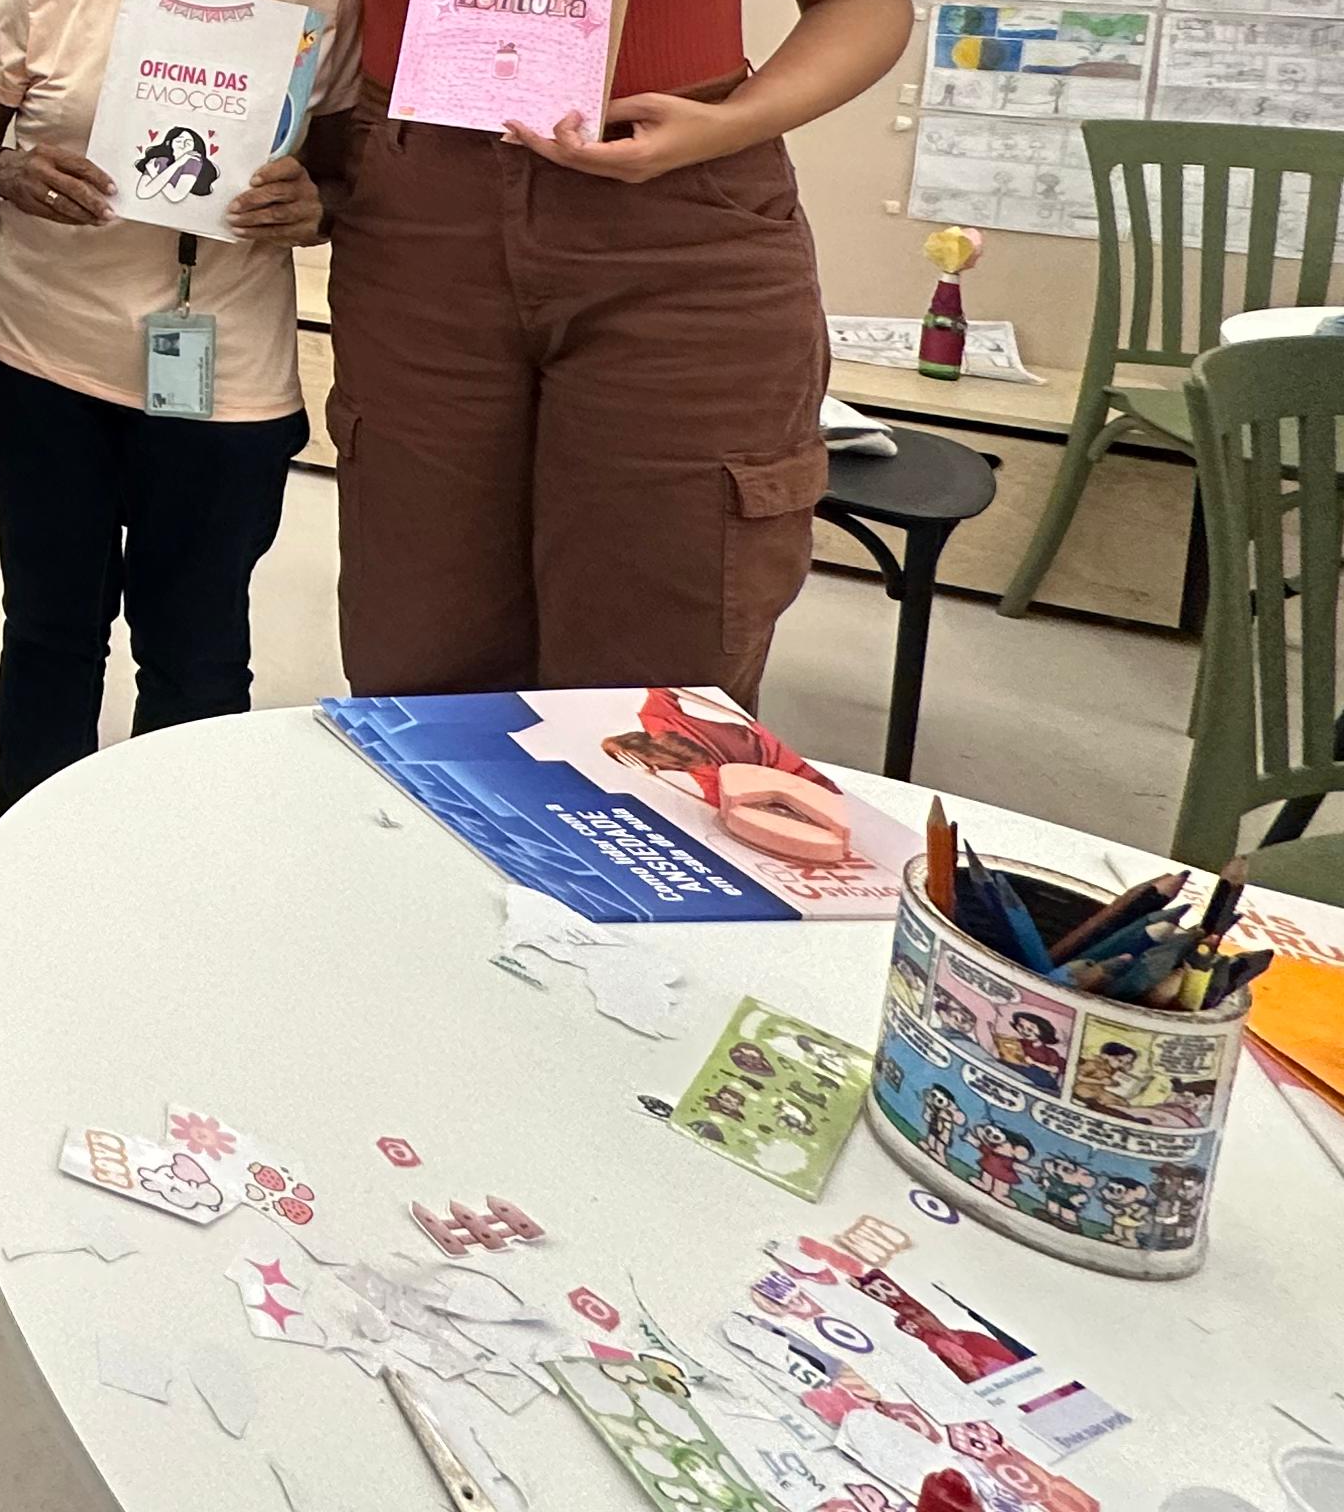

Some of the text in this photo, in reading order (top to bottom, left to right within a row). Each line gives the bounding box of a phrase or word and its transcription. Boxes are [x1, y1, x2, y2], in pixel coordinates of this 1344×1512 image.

[140, 59, 249, 93] OFICINA DAS
[135, 82, 249, 116] EMOÇÕES
[611, 807, 653, 831] aula
[545, 803, 685, 902] Como lidar com a
[576, 809, 712, 894] ANSIEDADE
[646, 833, 676, 849] de
[669, 849, 712, 874] sala
[705, 875, 744, 897] em
